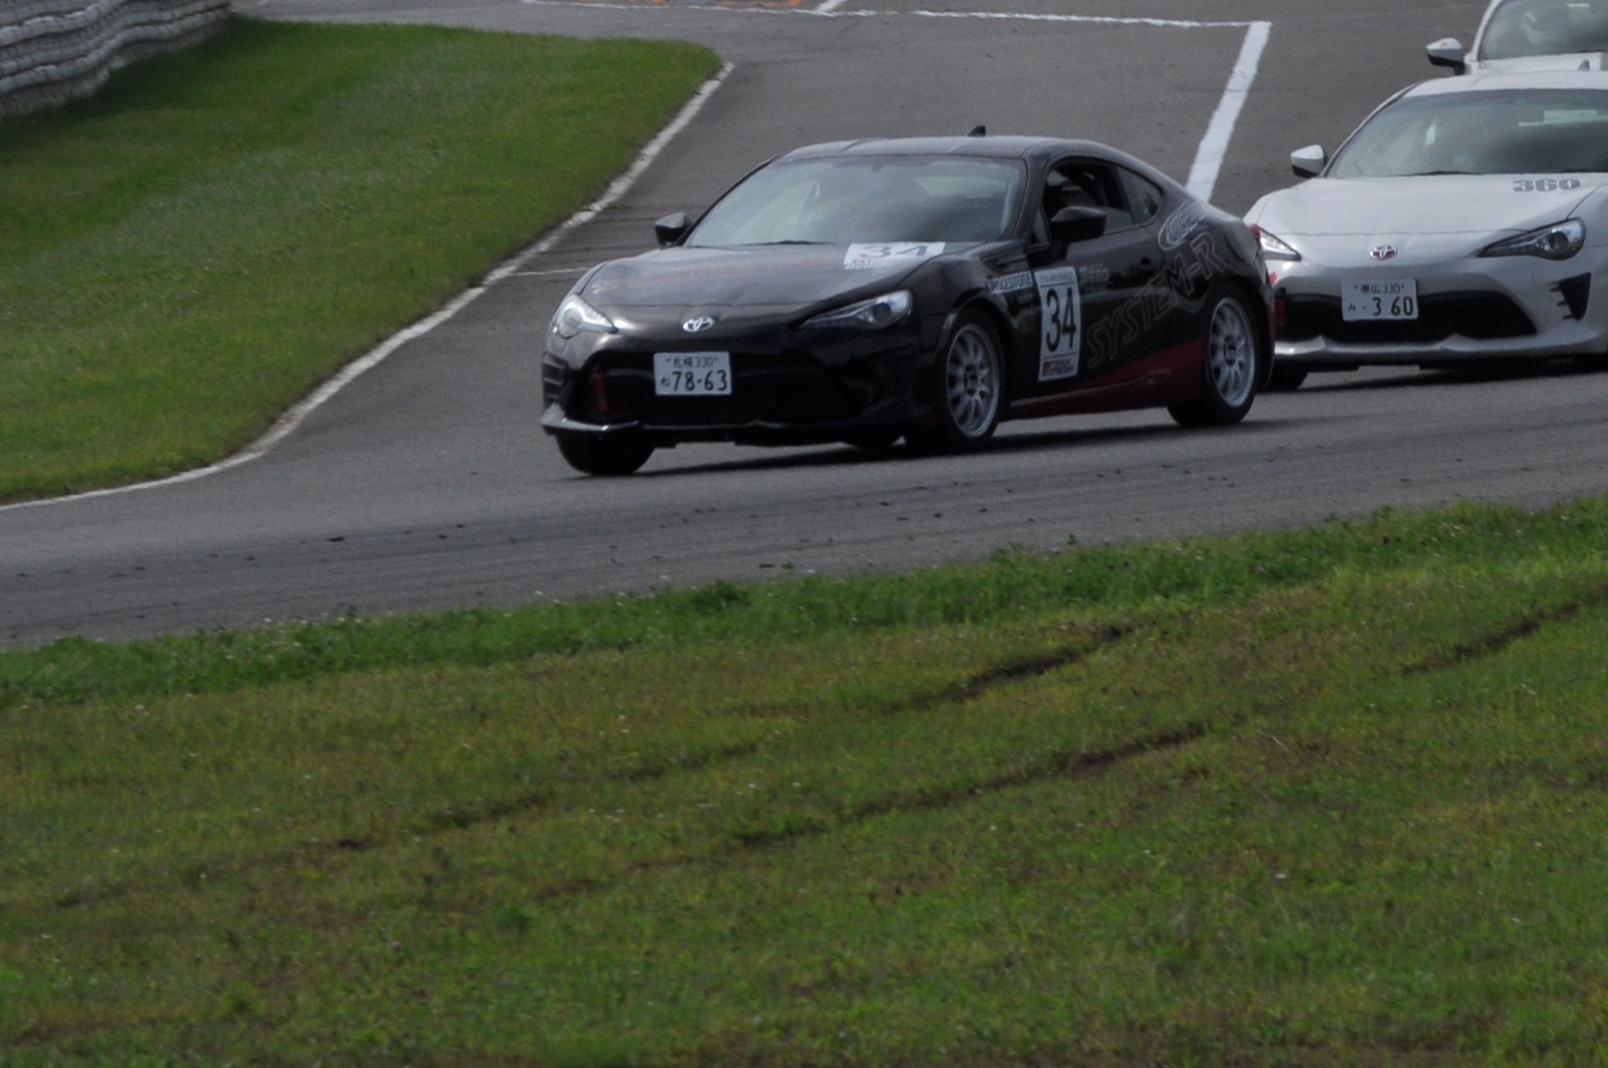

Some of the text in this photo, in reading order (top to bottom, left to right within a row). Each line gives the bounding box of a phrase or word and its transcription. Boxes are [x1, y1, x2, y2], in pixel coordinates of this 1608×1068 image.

[1512, 178, 1581, 192] 360
[858, 245, 929, 258] 34
[1046, 287, 1077, 352] 34
[672, 369, 728, 392] 78-63
